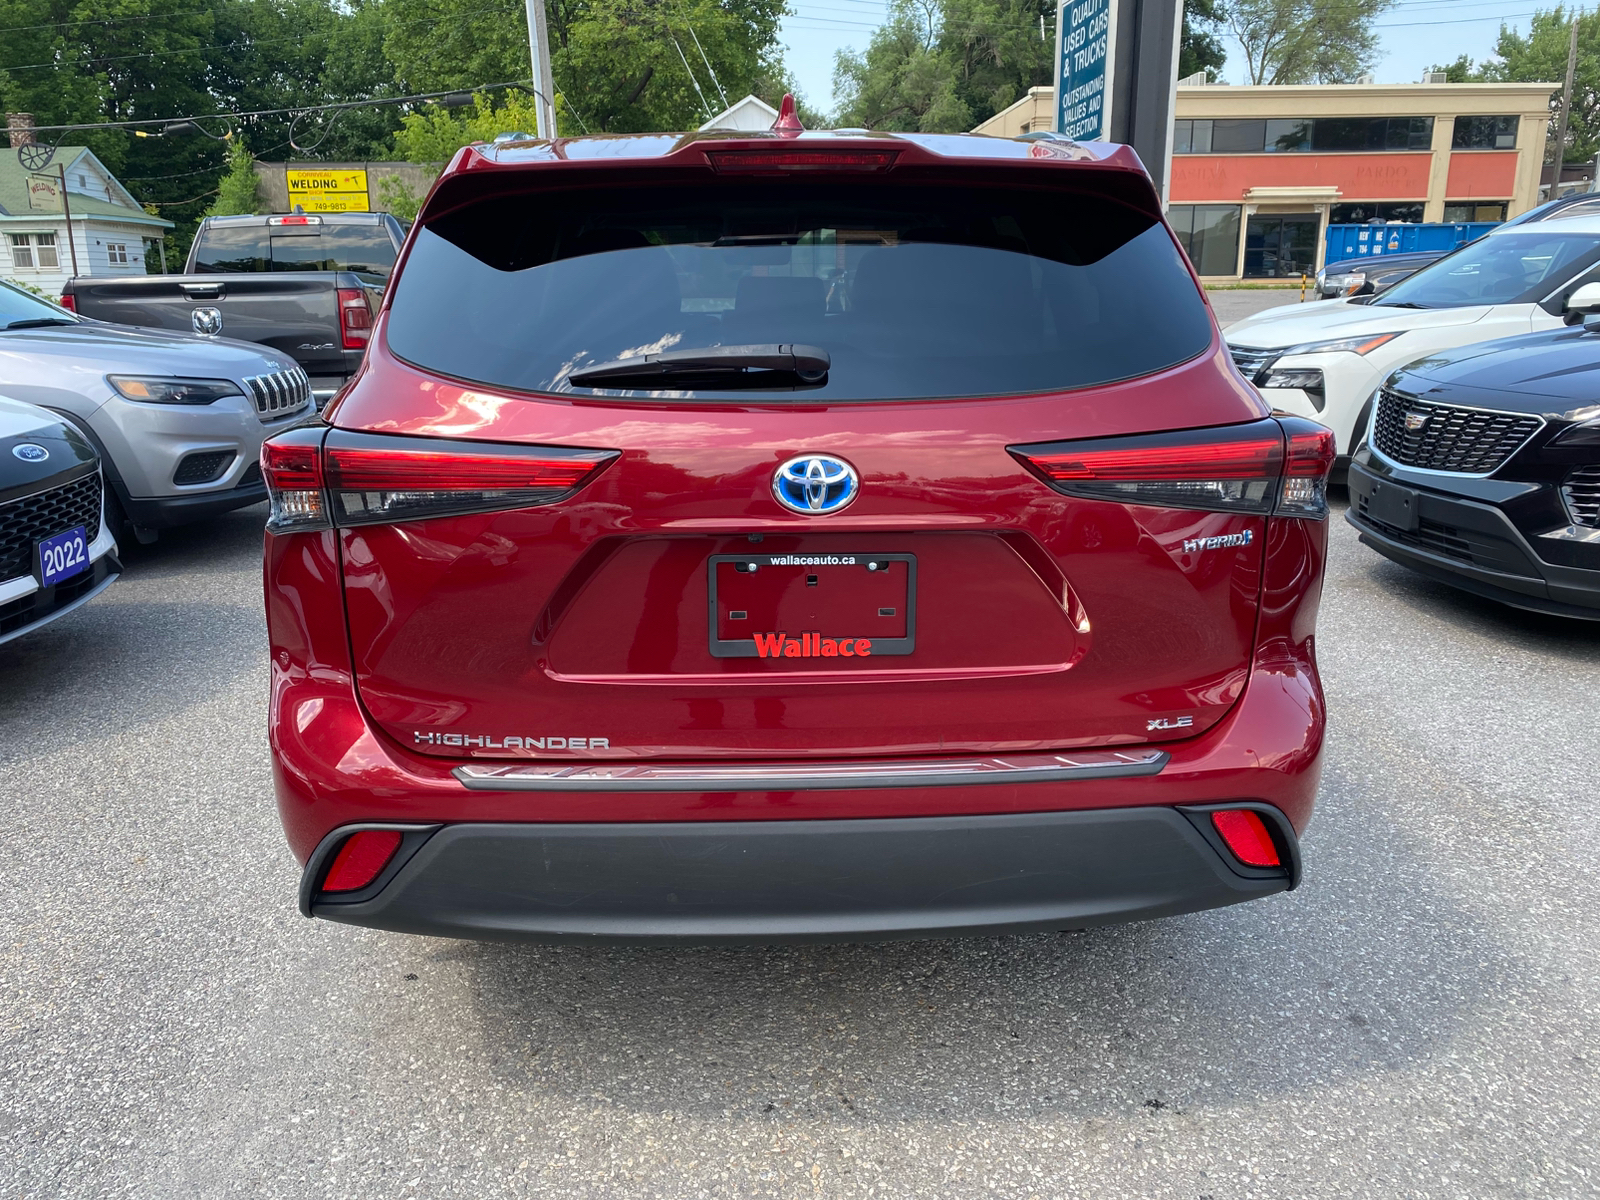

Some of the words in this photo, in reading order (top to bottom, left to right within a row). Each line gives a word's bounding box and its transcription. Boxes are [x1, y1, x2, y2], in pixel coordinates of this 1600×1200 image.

[1064, 26, 1086, 54] USED
[1088, 8, 1108, 40] CARS
[1063, 57, 1070, 78] &
[1074, 34, 1107, 73] TRUCKS
[1062, 73, 1104, 109] OUTSTANDING
[1064, 101, 1087, 125] VALUES
[1088, 94, 1101, 115] AND
[1065, 113, 1099, 139] SELECTION
[31, 182, 56, 196] WELDING
[290, 179, 338, 189] WELDING
[314, 202, 347, 210] 749-9813
[1183, 533, 1244, 553] HYBRID
[44, 536, 86, 577] 2022
[770, 554, 856, 566] wallaceauto.ca
[752, 631, 872, 658] Wallace
[1146, 715, 1193, 731] XLE
[413, 730, 610, 750] HIGHLANDER
